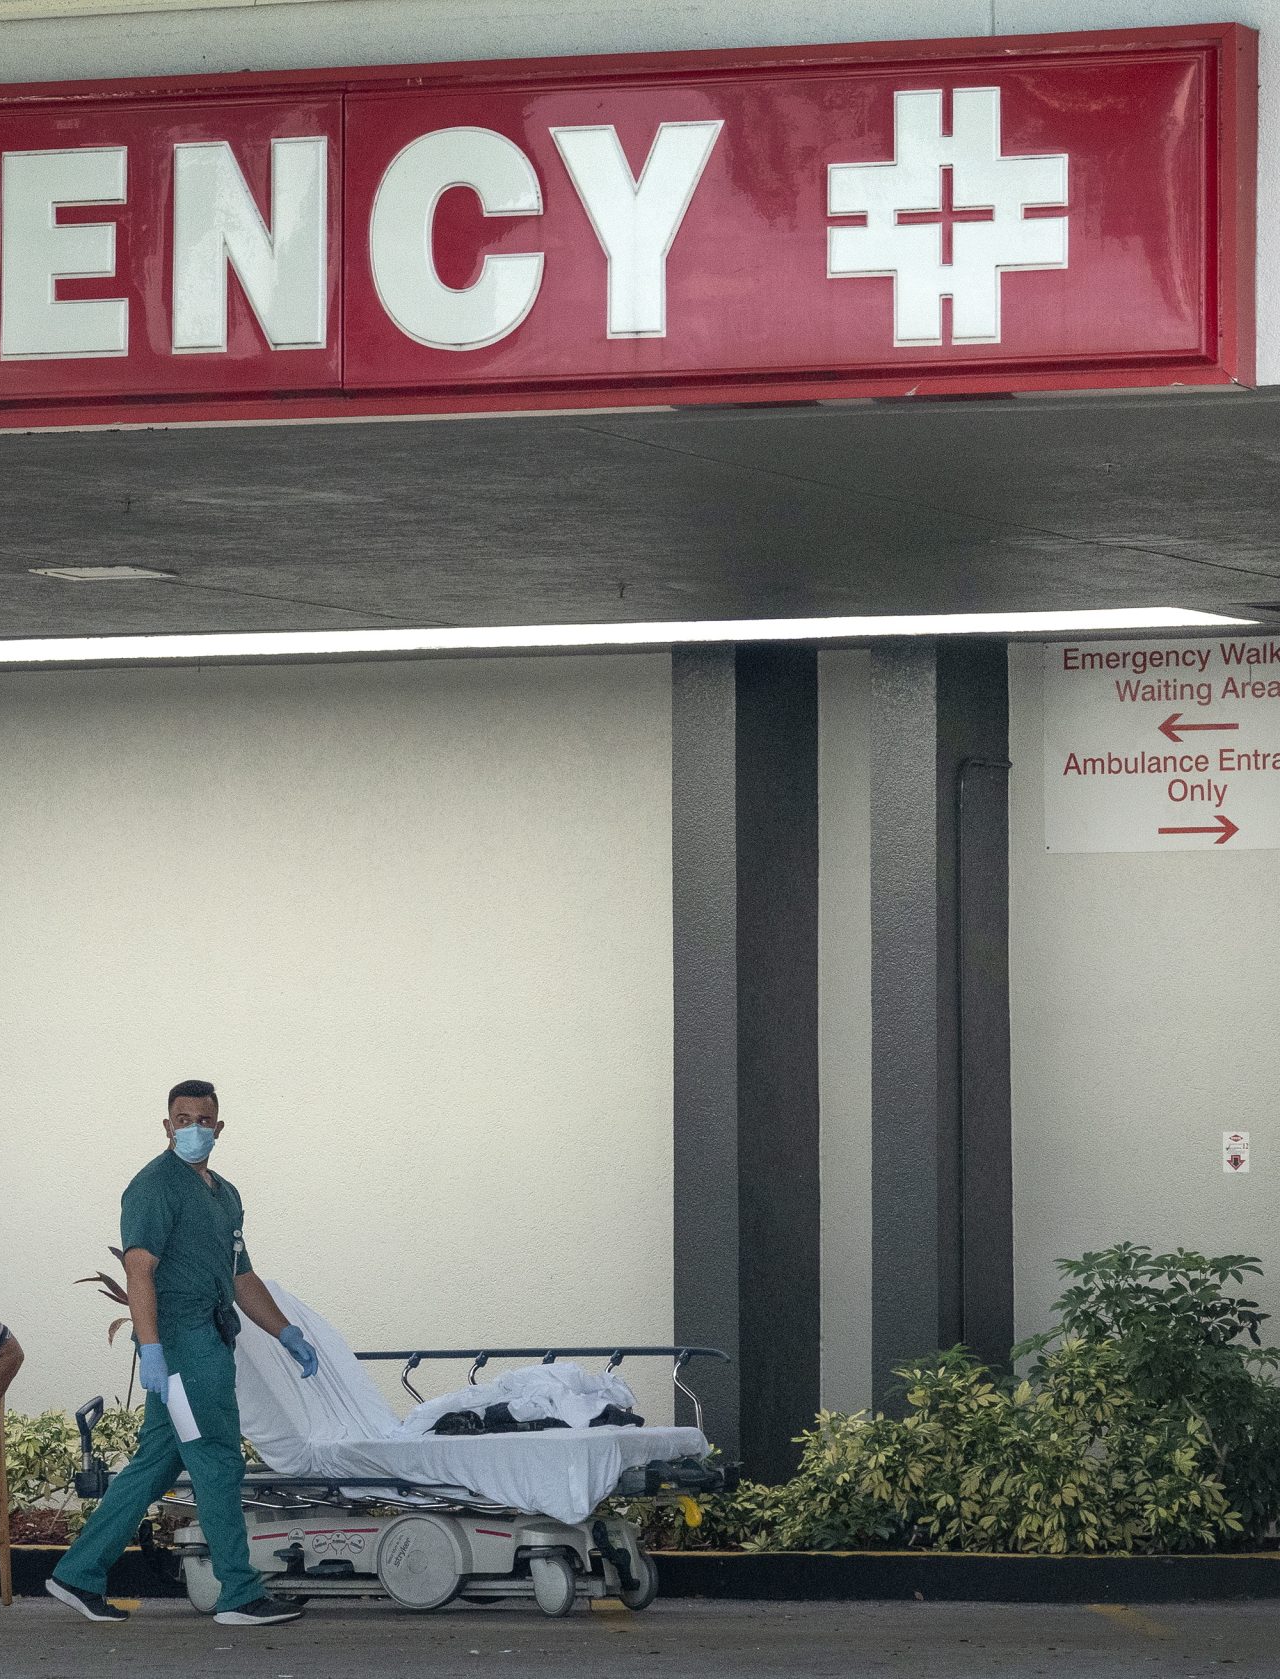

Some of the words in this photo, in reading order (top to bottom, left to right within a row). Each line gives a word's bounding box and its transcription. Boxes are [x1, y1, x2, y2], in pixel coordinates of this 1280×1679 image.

[1063, 648, 1211, 675] Emergency
[1116, 679, 1212, 706] Waiting
[1221, 676, 1280, 700] Area
[1063, 751, 1209, 775] Ambulance
[1167, 778, 1228, 808] Only
[393, 1537, 410, 1568] stryker
